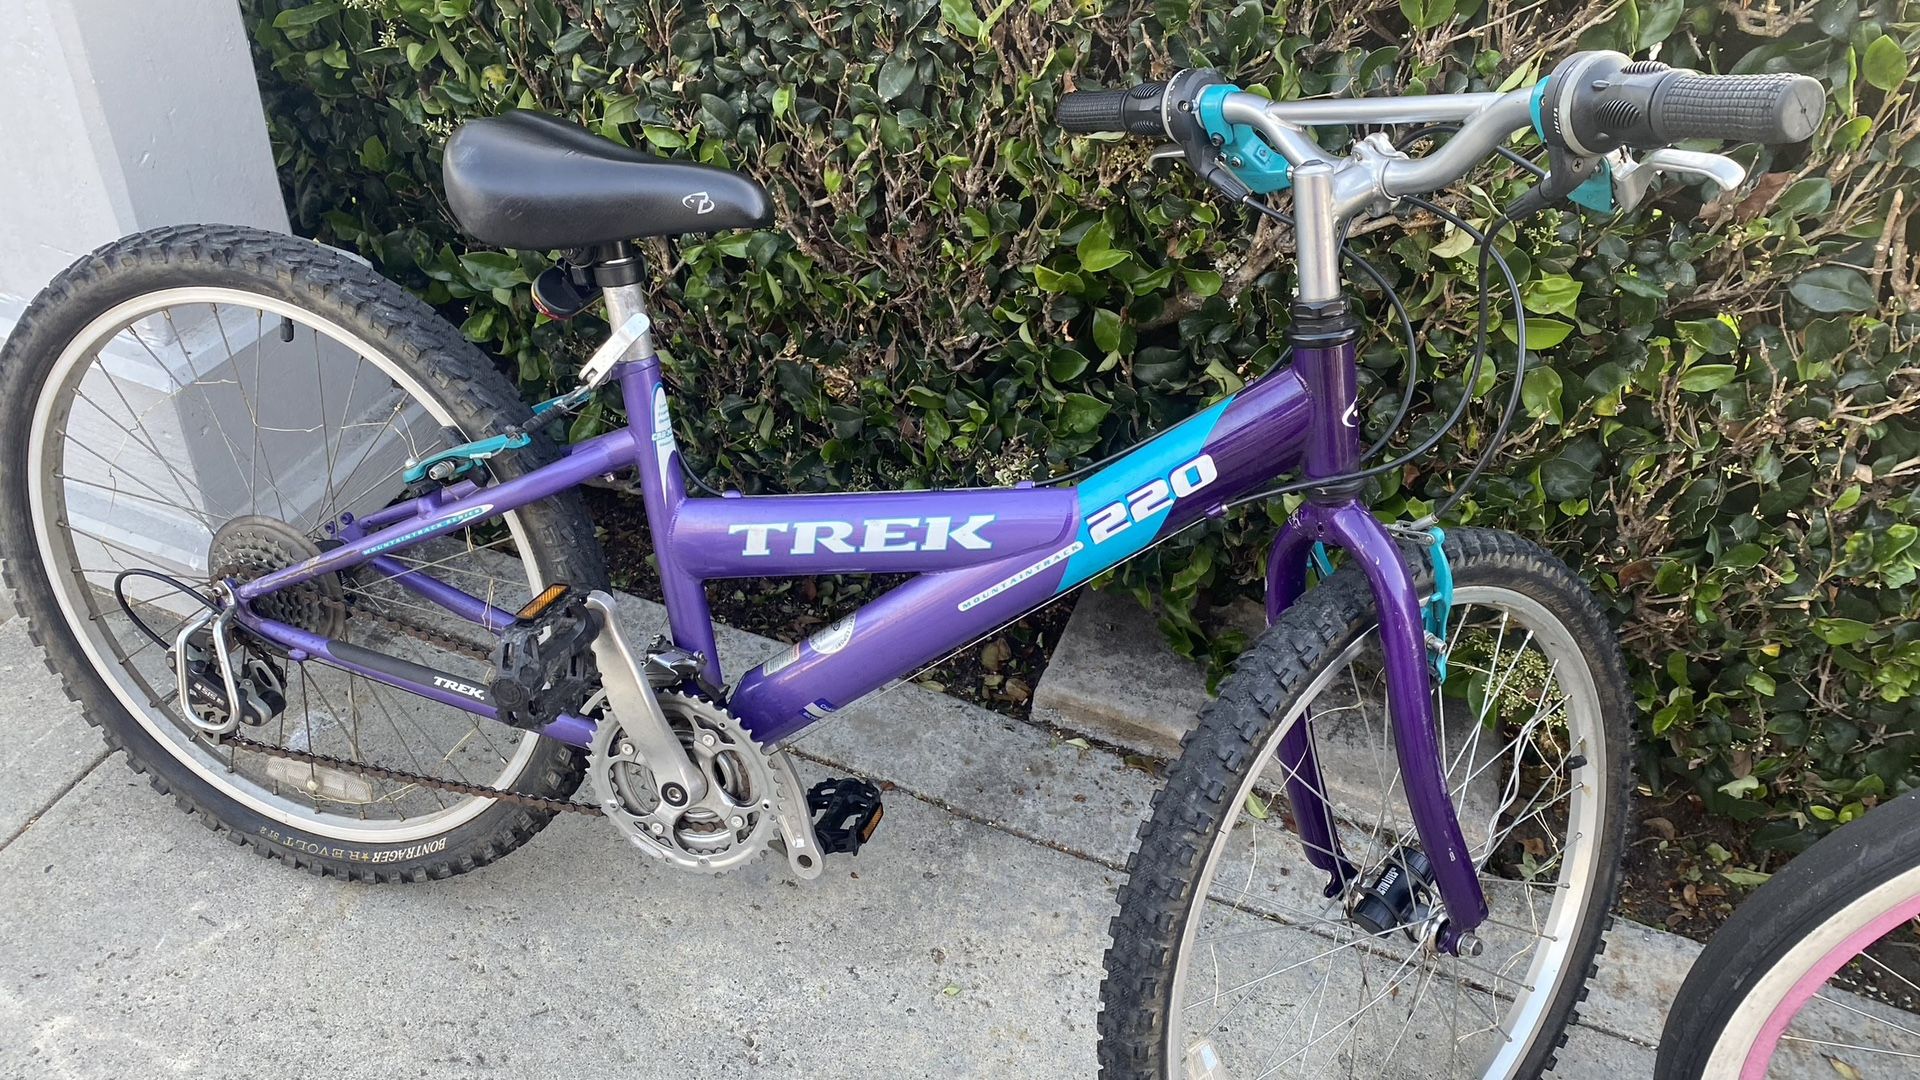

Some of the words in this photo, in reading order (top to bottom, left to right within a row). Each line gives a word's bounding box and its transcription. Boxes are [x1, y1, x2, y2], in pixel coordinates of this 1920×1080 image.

[1086, 454, 1218, 545] 220
[362, 523, 441, 555] MOUNTAINTRACK
[728, 515, 995, 556] TREK
[962, 544, 1080, 609] MOUNTAINTRACK
[283, 836, 361, 862] REVOLT
[371, 837, 447, 863] BONTRAGER
